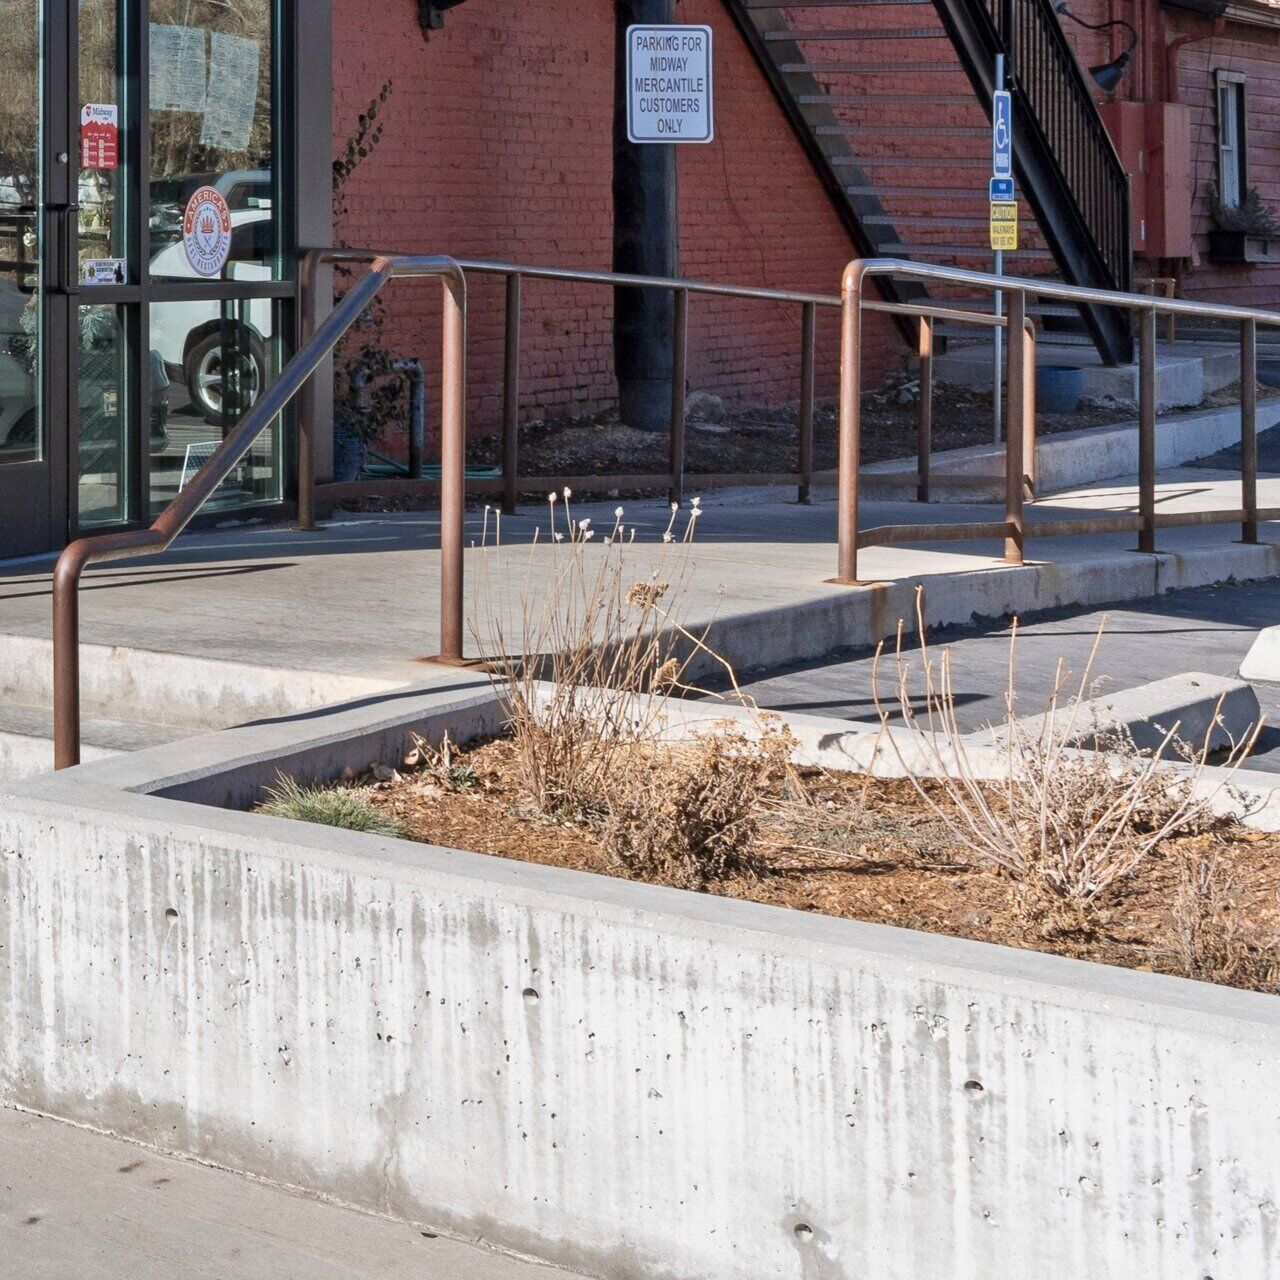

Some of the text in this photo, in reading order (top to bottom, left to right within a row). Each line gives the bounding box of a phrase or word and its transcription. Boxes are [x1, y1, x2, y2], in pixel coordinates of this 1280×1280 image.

[636, 36, 702, 52] PARKING FOR
[650, 57, 688, 72] MIDWAY
[635, 78, 703, 92] MERCANTILE
[92, 107, 113, 118] Midway
[639, 98, 700, 113] CUSTOMERS
[657, 119, 683, 133] ONLY
[992, 206, 1017, 219] CAUTION
